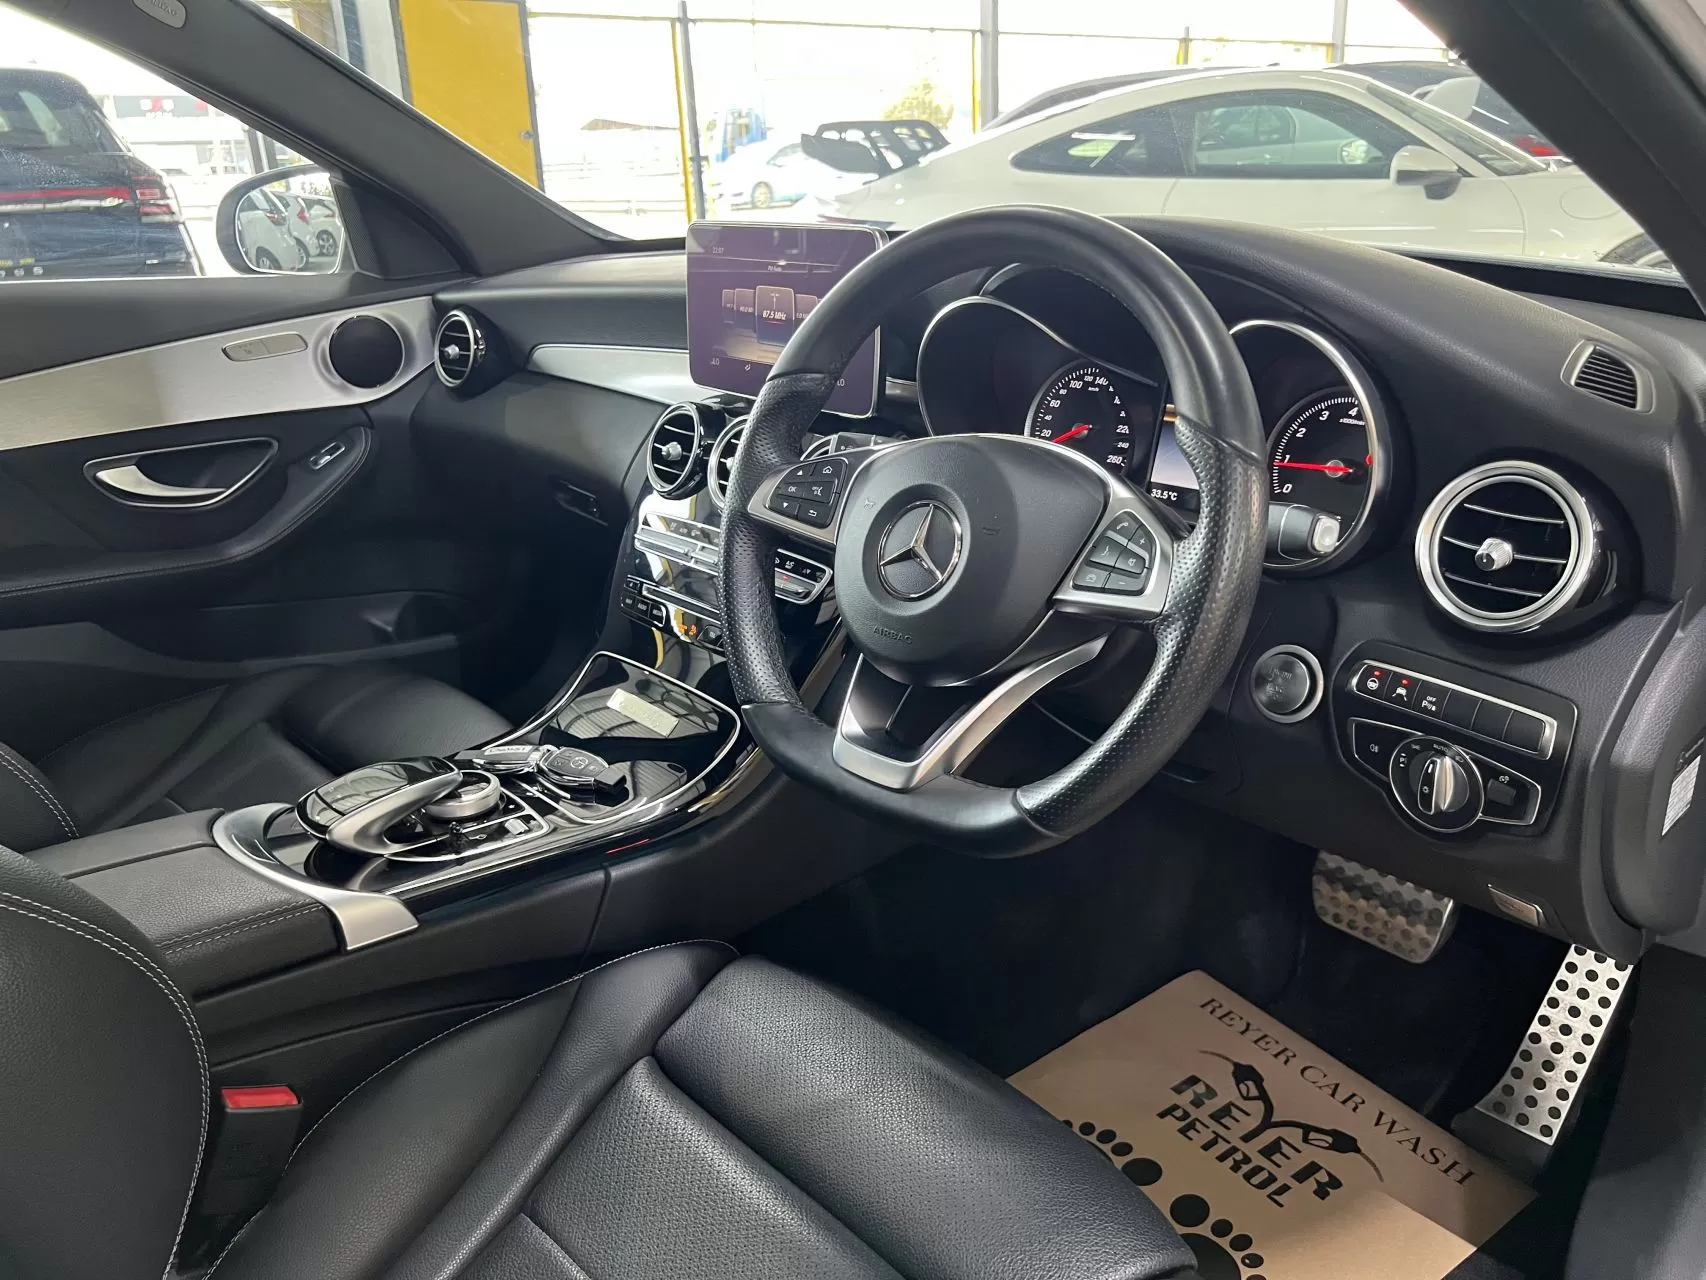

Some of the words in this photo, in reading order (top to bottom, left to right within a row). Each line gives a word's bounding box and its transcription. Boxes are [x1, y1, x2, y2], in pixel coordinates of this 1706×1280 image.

[762, 310, 775, 319] 87.5
[775, 311, 787, 320] MHz
[1069, 380, 1083, 389] 100
[1049, 399, 1060, 408] 60
[1319, 410, 1330, 421] 3
[1347, 407, 1358, 417] 4
[1040, 429, 1052, 438] 20
[1295, 427, 1307, 438] 2
[1106, 454, 1122, 465] 260
[1283, 454, 1291, 463] 1
[787, 485, 798, 493] OK
[1282, 483, 1293, 493] 0
[1150, 488, 1178, 501] 33.5°C
[872, 624, 913, 645] AIRBAG
[1432, 743, 1450, 753] AUTO
[1199, 997, 1298, 1066] REYER
[1299, 1065, 1367, 1113] CAR
[1373, 1110, 1476, 1185] WASH
[1170, 1063, 1344, 1201] REYER
[1155, 1103, 1293, 1208] PETROL
